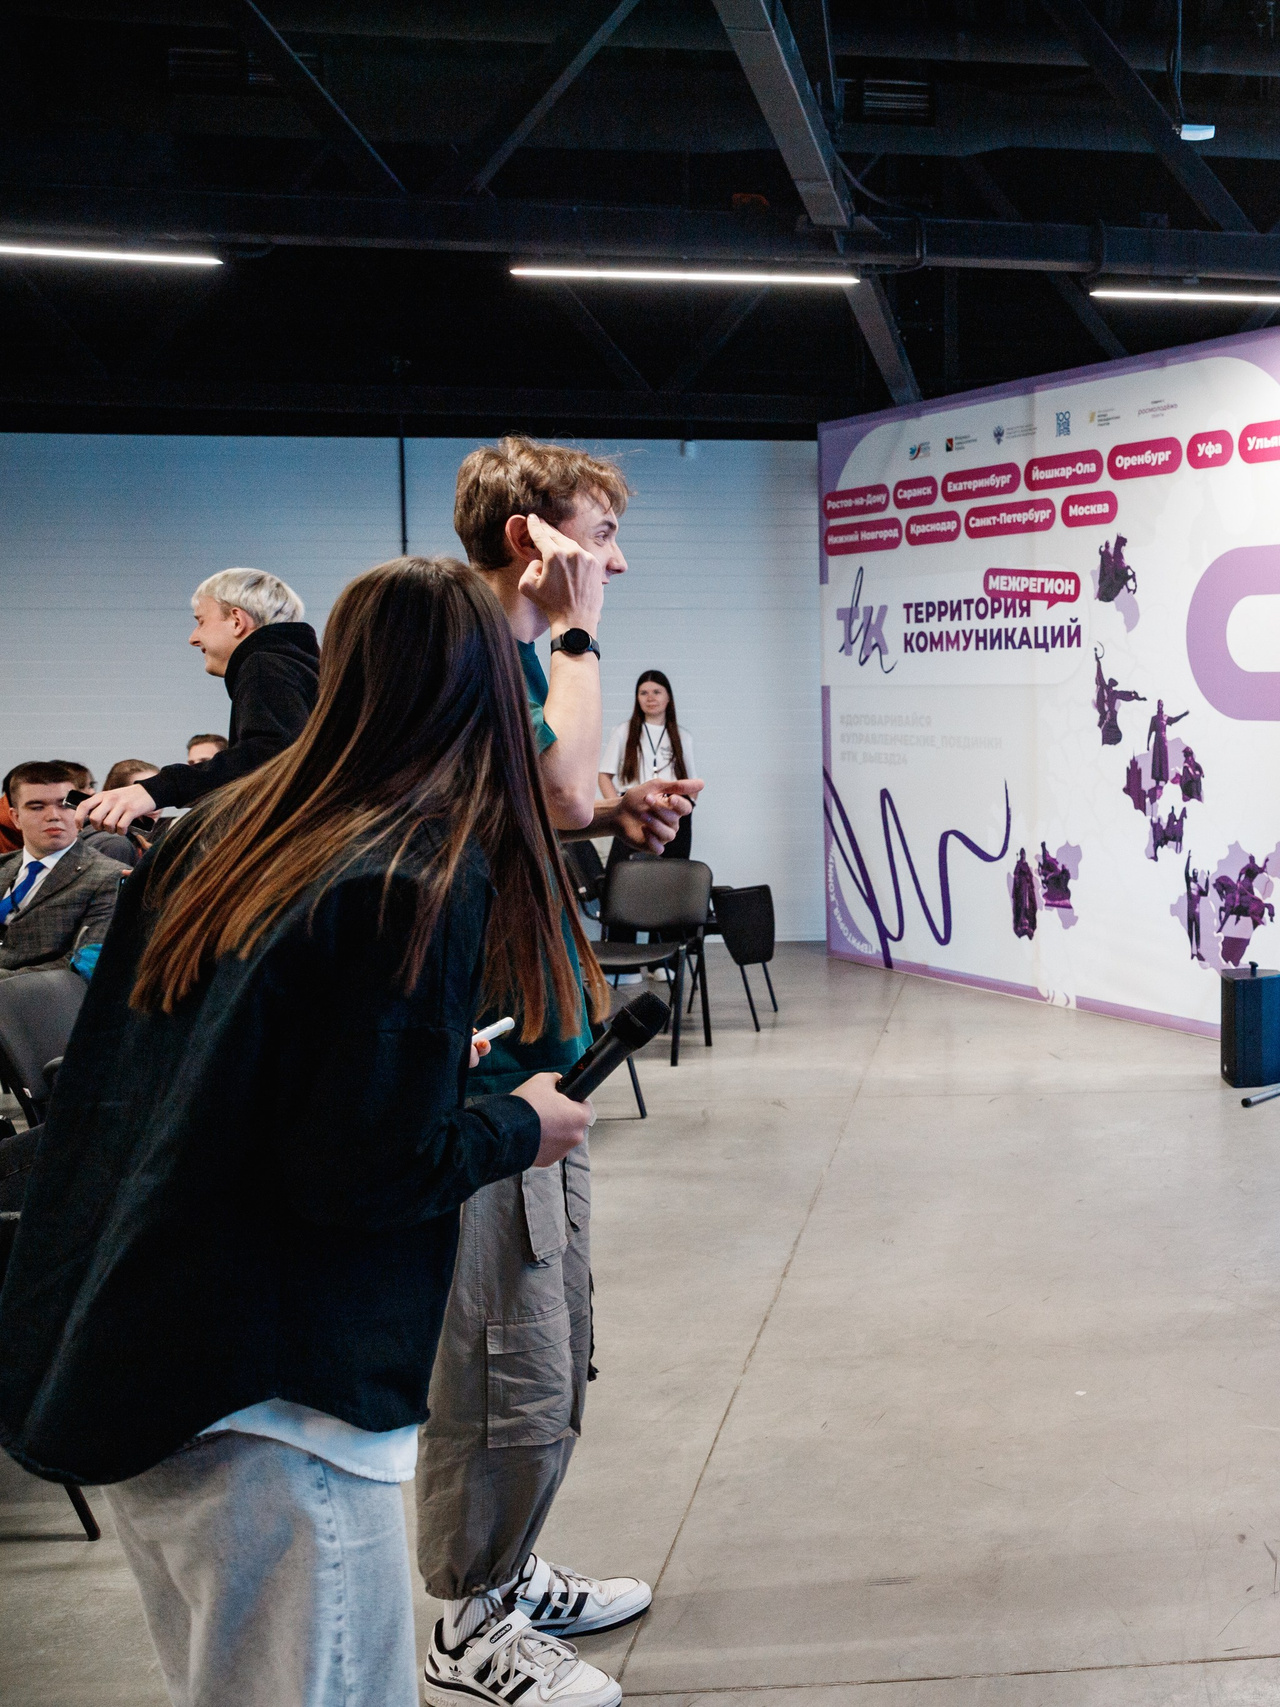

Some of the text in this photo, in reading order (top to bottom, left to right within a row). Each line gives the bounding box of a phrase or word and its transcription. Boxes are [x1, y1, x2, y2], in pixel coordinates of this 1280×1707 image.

[1197, 441, 1223, 458] Уфа
[1115, 449, 1172, 470] Оренбург
[1032, 462, 1097, 481] Йошкар-Ола
[947, 473, 1012, 493] Екатеринбург
[826, 492, 887, 511] Ростов-на-Дону
[897, 485, 932, 501] Саранск
[969, 508, 1052, 529] Санкт-Петербург
[1069, 503, 1110, 517] Москва
[827, 528, 899, 545] Нижний Новгород
[910, 520, 957, 536] Краснодар
[988, 574, 1076, 596] МЕЖРЕГИОН
[903, 597, 1031, 624] ТЕРРИТОРИЯ
[903, 617, 1082, 653] КОММУНИКАЦИЙ
